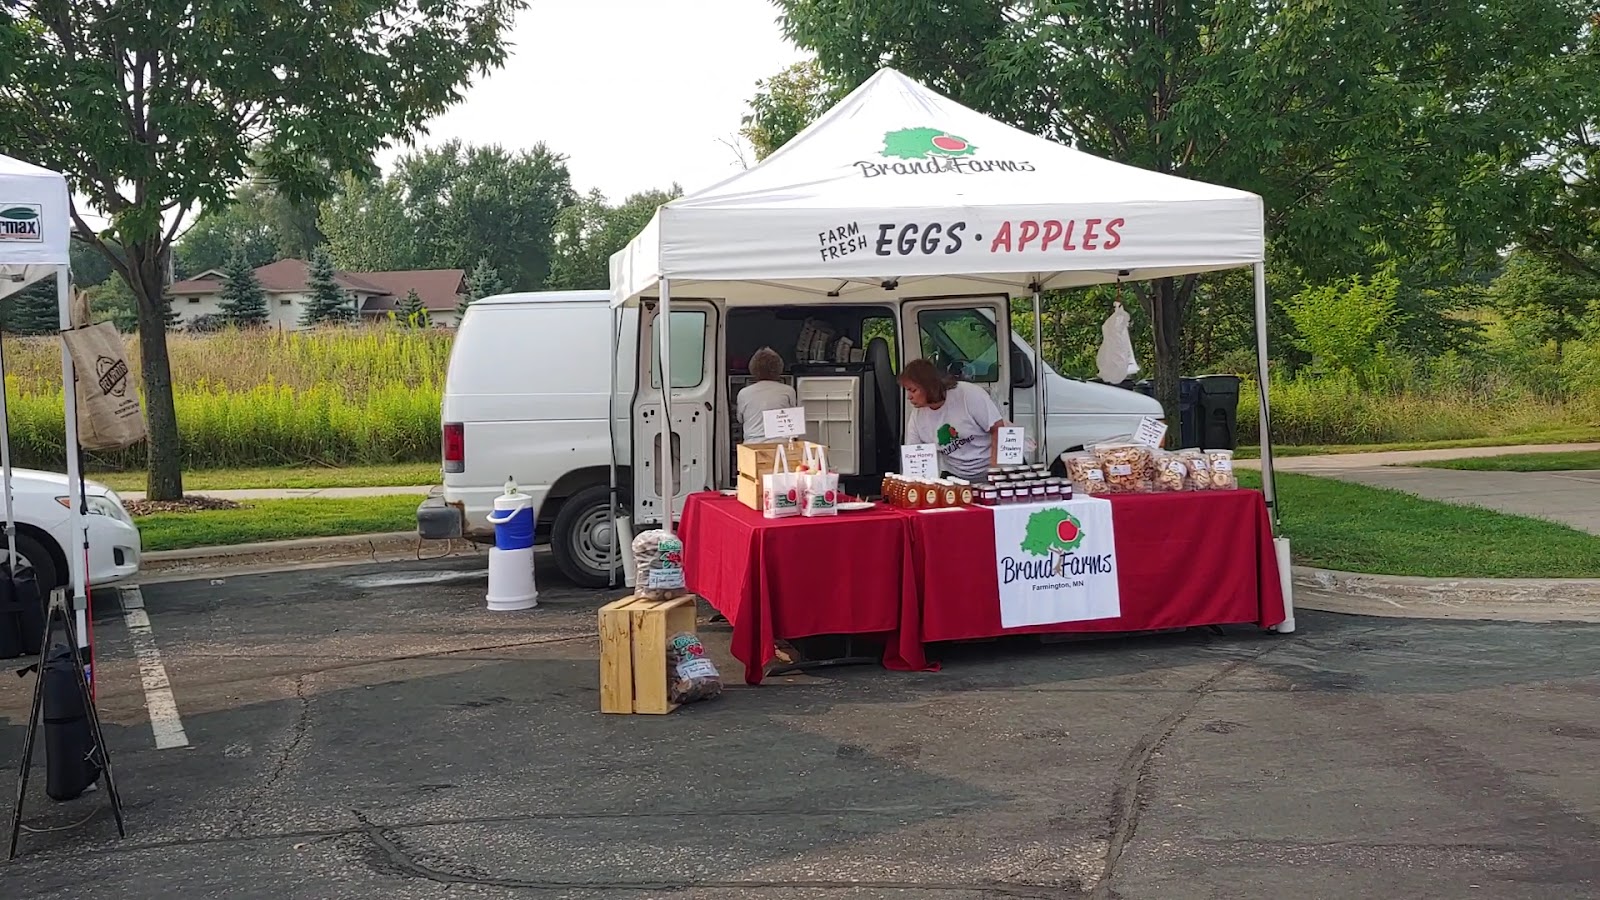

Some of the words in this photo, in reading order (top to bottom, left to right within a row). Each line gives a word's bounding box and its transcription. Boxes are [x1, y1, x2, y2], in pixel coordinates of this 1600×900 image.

[853, 157, 946, 178] Brand
[949, 157, 1036, 175] Farms
[819, 221, 860, 246] FARM
[875, 222, 966, 256] EGGS
[990, 217, 1126, 253] APPLES
[820, 235, 868, 262] FRESH
[1001, 552, 1055, 584] Brand
[1060, 552, 1112, 578] Farms
[1032, 582, 1071, 591] Farmington,
